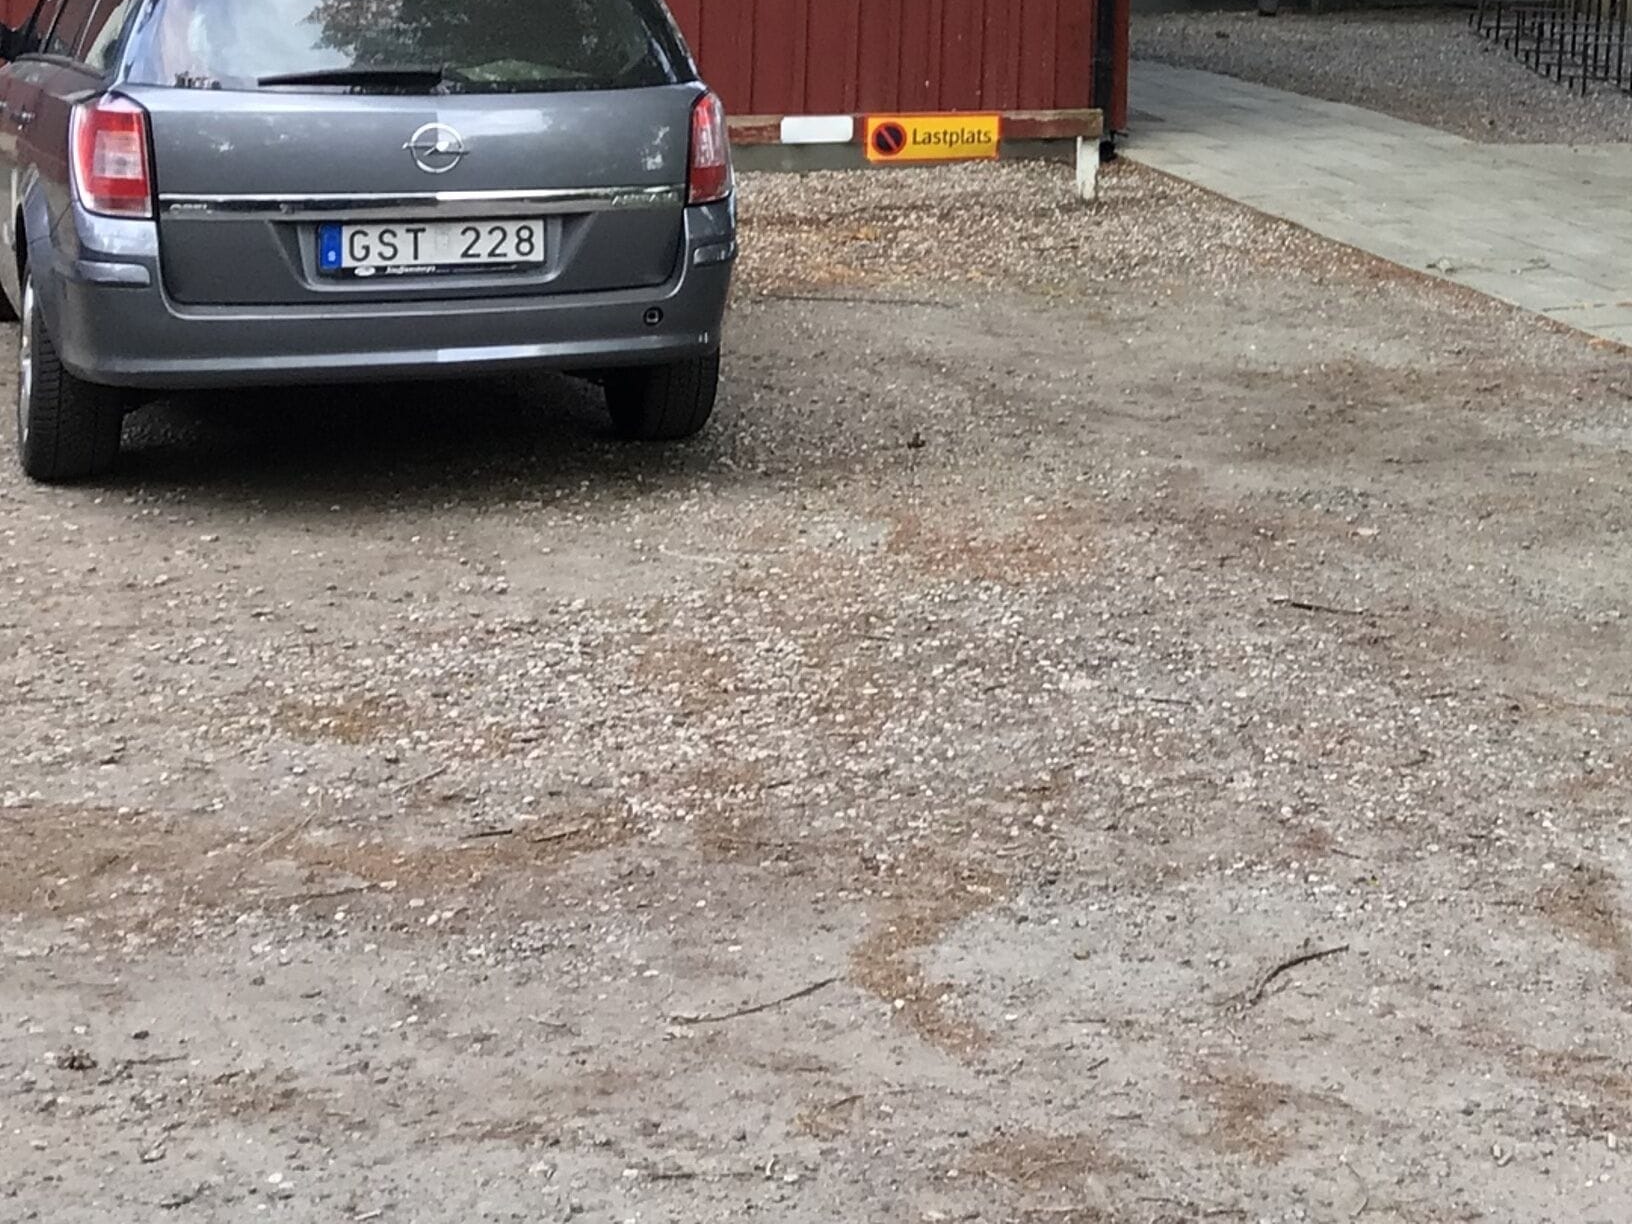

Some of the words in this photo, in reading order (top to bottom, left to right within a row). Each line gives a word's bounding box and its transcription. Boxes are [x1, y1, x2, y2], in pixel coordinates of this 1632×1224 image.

[912, 128, 992, 148] Lastplats
[350, 227, 427, 262] GST
[460, 225, 535, 259] 228
